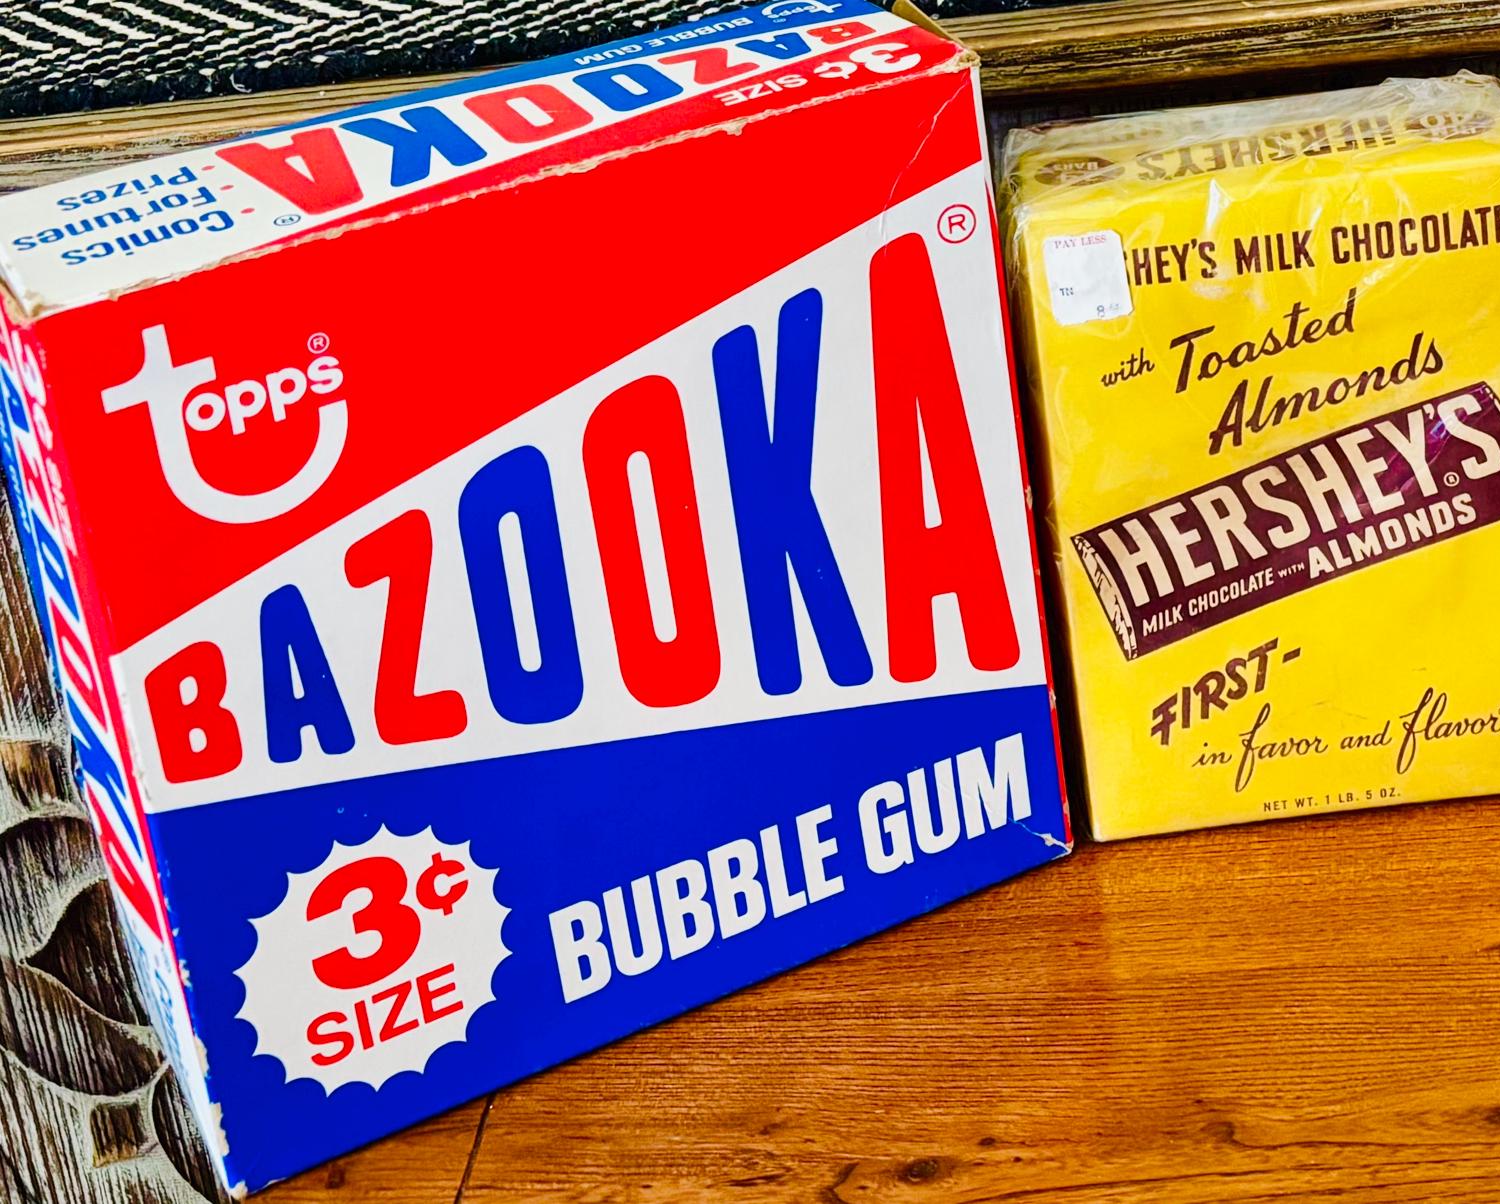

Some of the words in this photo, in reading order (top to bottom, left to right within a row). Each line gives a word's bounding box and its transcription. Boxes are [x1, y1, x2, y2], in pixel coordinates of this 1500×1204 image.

[573, 43, 643, 66] GUM
[643, 17, 754, 48] BUBBLE
[215, 22, 876, 215] BAZOOKA
[714, 74, 808, 106] SIZE
[12, 186, 217, 252] Fortunes
[57, 166, 198, 212] Prizes
[60, 210, 234, 266] Comics
[1054, 238, 1077, 249] PAY
[1080, 234, 1107, 246] LESS
[1234, 230, 1315, 275] MILK
[1101, 348, 1155, 388] with
[1169, 288, 1357, 393] Toasted
[1208, 331, 1445, 455] Almonds
[144, 232, 1021, 785] BAZOOKA
[1141, 603, 1184, 637] MILK
[1188, 567, 1274, 618] CHOCOLATE
[1277, 562, 1305, 580] WITH
[1307, 492, 1478, 580] ALMONDS
[1192, 741, 1234, 768] in
[1234, 702, 1329, 793] favor
[1340, 720, 1392, 751] and
[1263, 800, 1288, 812] NET
[1294, 796, 1318, 808] WT.
[1325, 794, 1332, 805] 1
[1338, 792, 1360, 804] LB.
[1365, 790, 1373, 800] 5
[1379, 787, 1401, 799] OZ.
[548, 803, 846, 1005] BUBBLE
[856, 731, 1034, 876] GUM
[306, 962, 464, 1067] SIZE
